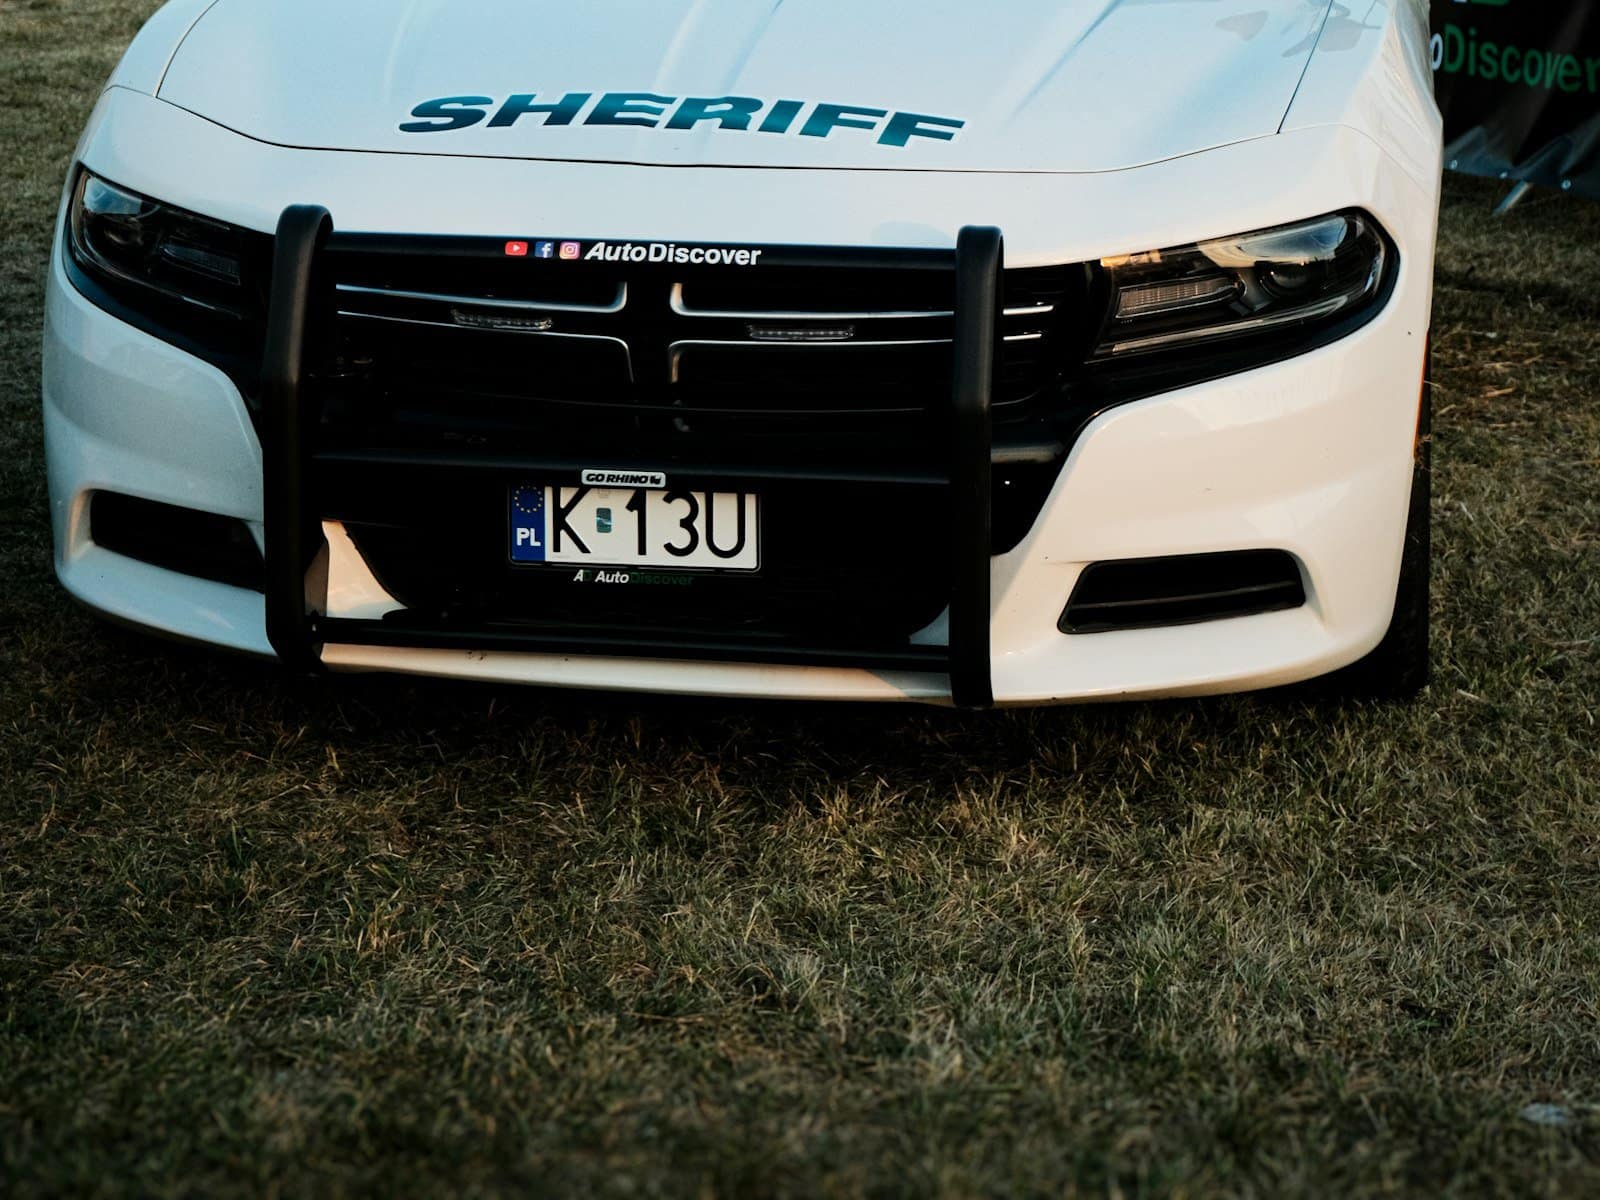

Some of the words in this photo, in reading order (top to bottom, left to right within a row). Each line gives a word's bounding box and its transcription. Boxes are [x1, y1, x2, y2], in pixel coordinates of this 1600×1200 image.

[399, 93, 965, 147] SHERIFF
[584, 242, 762, 265] AutoDiscover
[586, 473, 605, 483] GO
[606, 474, 648, 484] RHINO
[552, 487, 592, 553] K
[625, 488, 746, 558] 13U
[516, 528, 541, 546] PL
